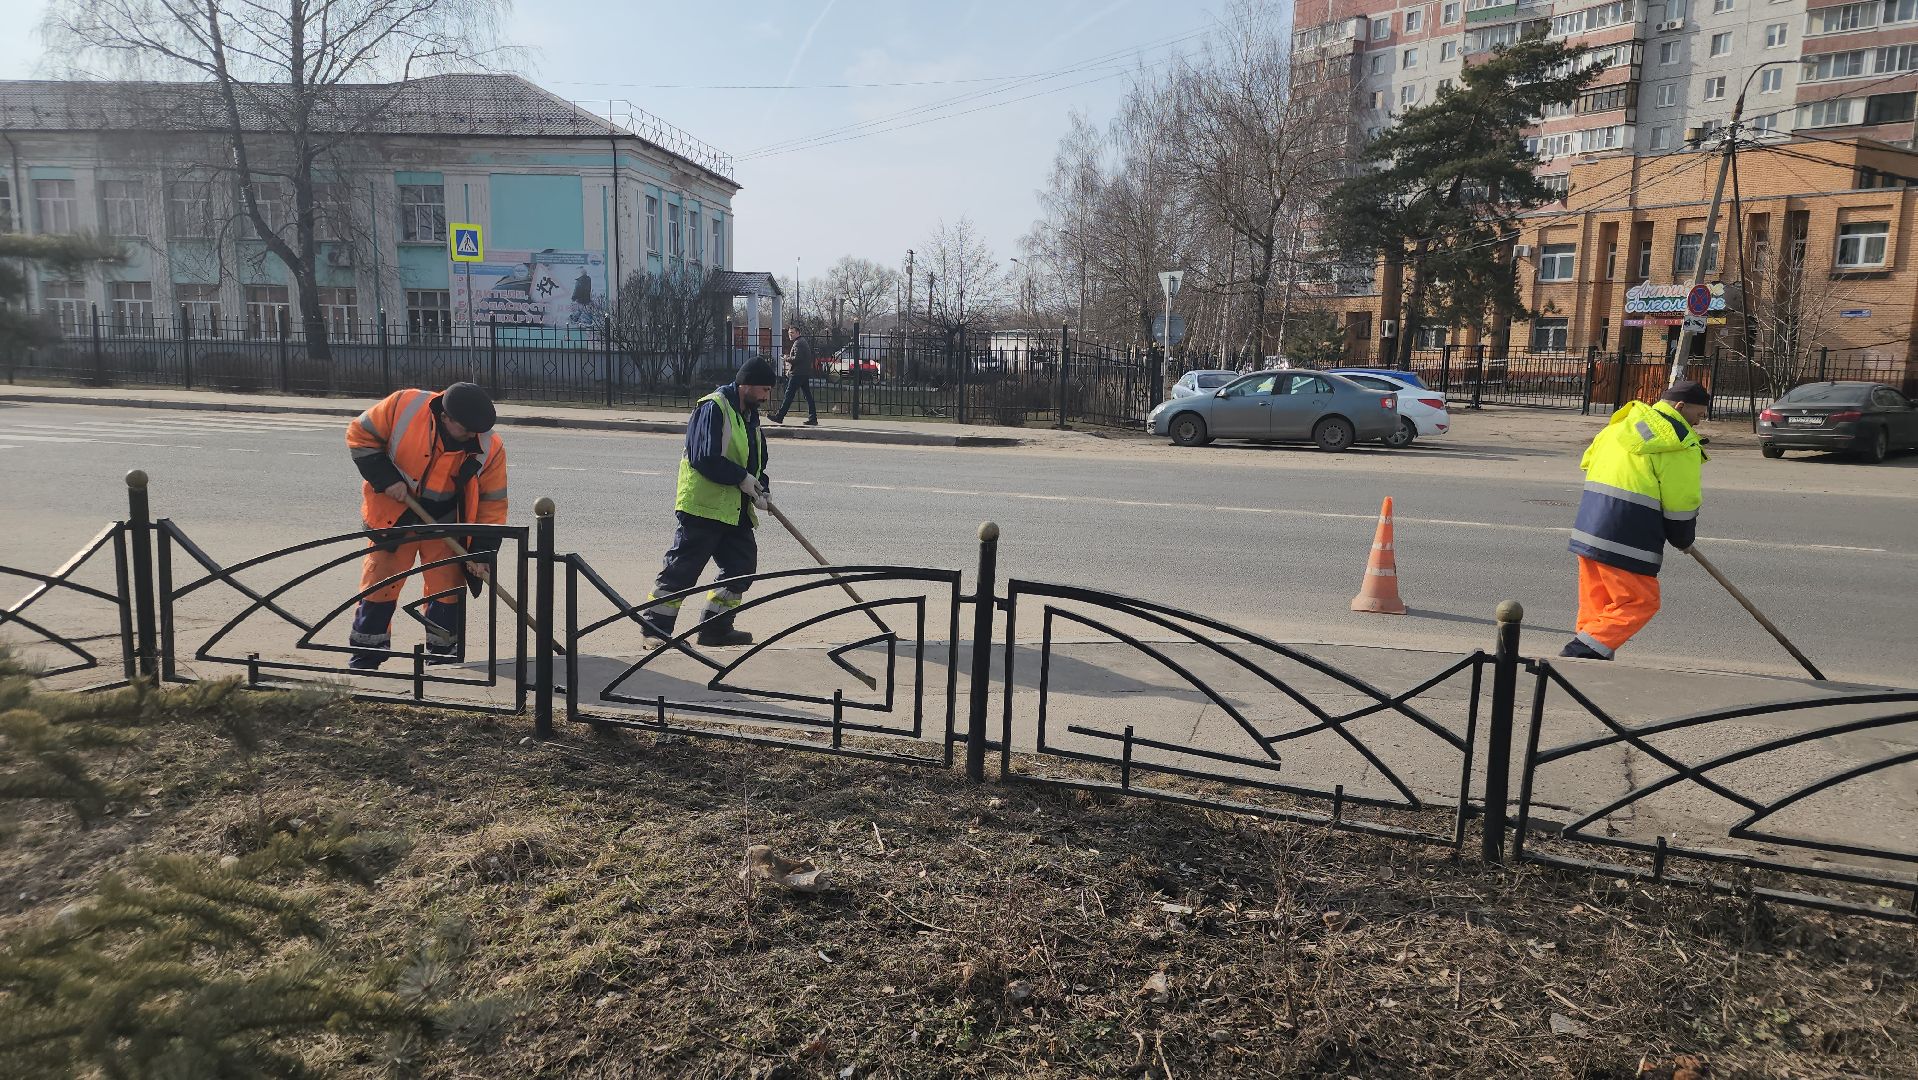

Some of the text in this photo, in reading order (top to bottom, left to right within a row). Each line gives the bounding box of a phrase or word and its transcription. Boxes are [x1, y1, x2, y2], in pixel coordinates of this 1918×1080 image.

[1626, 280, 1706, 298] Актив
[458, 301, 551, 313] БОПАСНОСТЬ
[1625, 295, 1725, 312] долголеие
